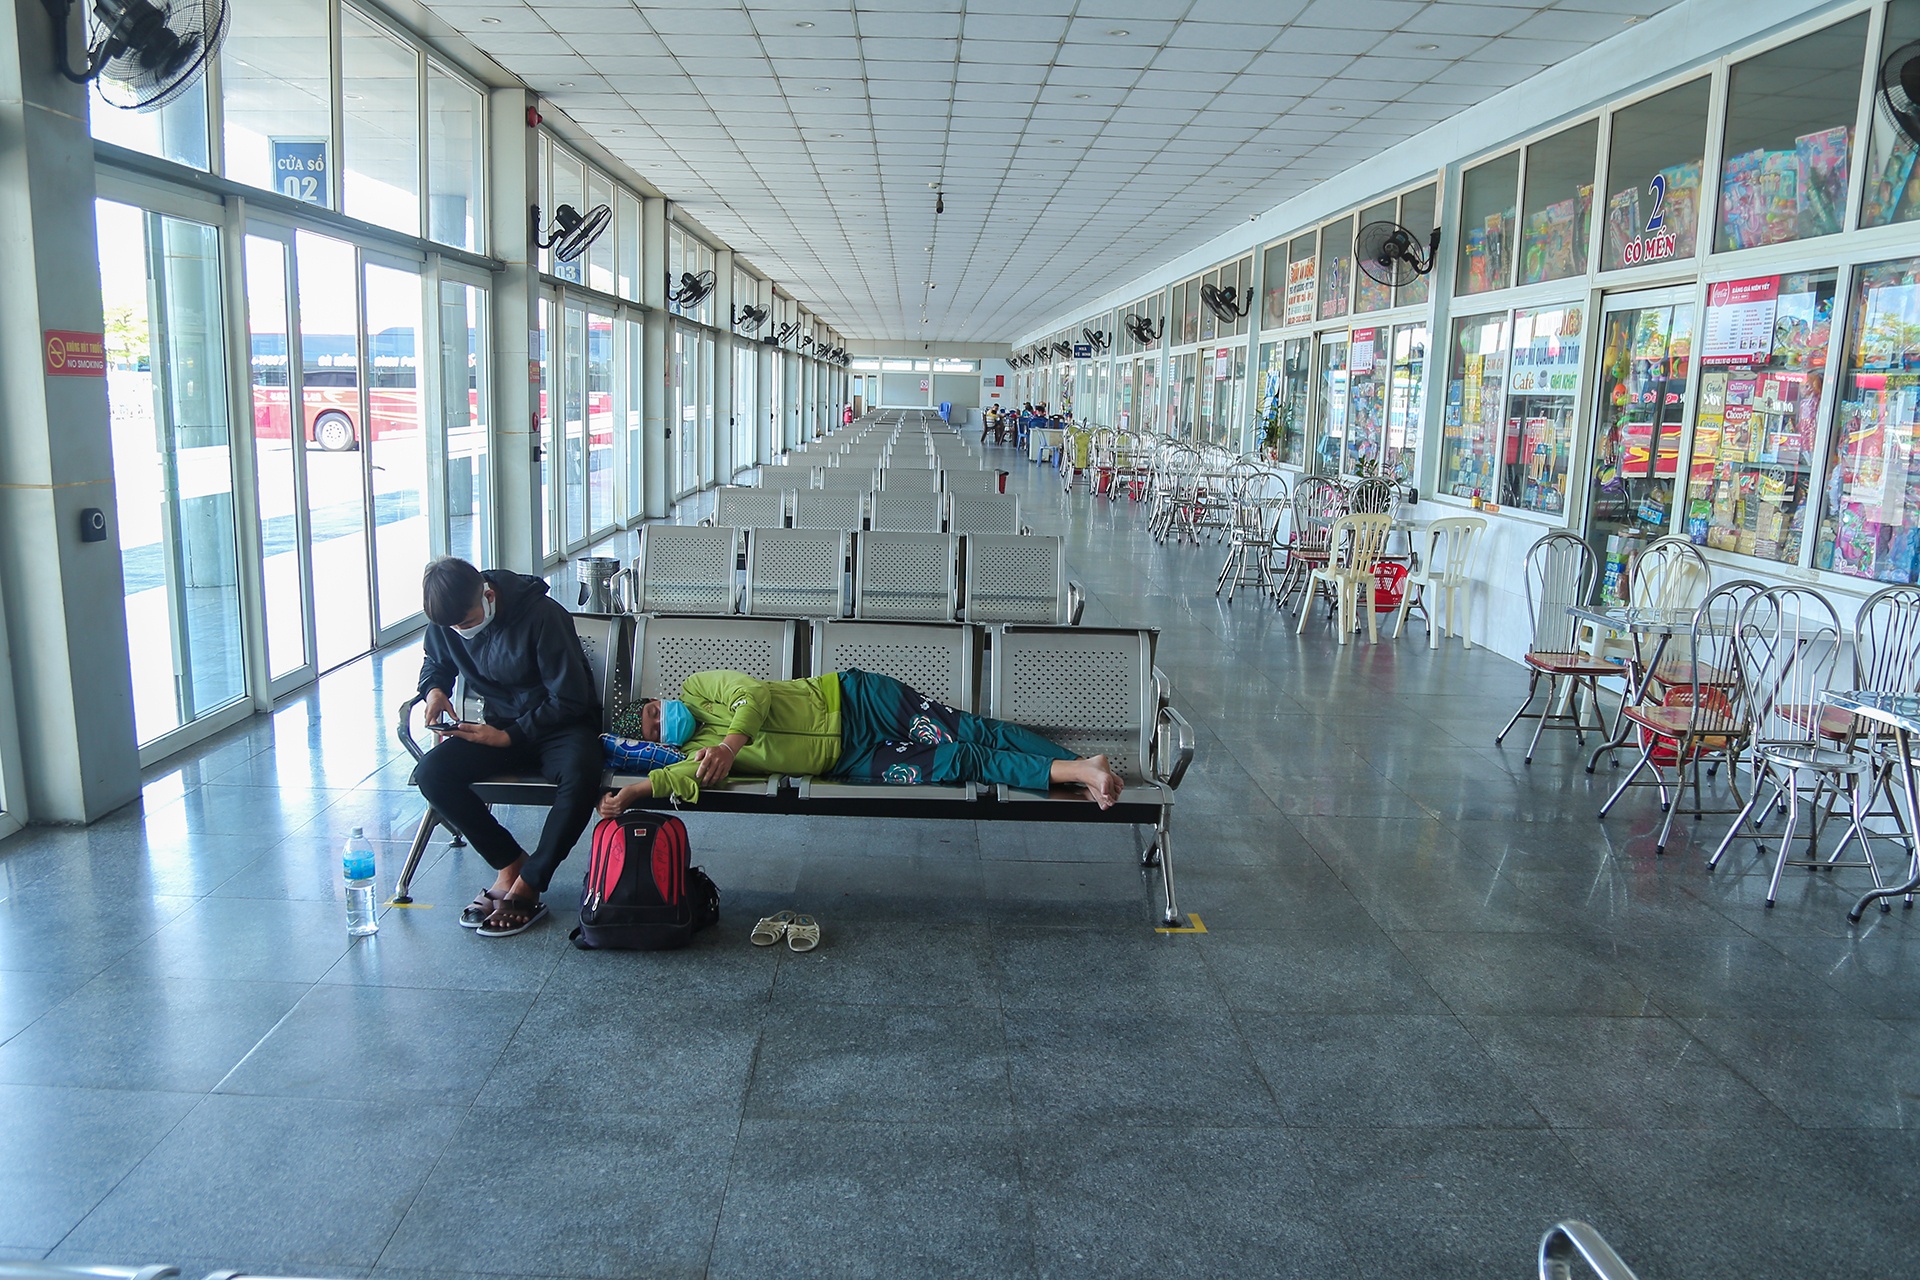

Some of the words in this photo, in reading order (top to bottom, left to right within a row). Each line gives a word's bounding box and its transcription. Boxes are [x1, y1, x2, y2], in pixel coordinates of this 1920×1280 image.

[277, 154, 304, 171] CỬA
[307, 153, 325, 172] SỐ
[284, 175, 318, 201] 02
[1645, 173, 1667, 233] 2
[1623, 234, 1642, 265] CÔ
[1643, 224, 1676, 262] MẾN
[555, 265, 576, 280] 03
[1331, 256, 1338, 290] 3
[67, 360, 77, 368] NO
[77, 360, 104, 369] SMOKING
[1513, 372, 1535, 391] Café
